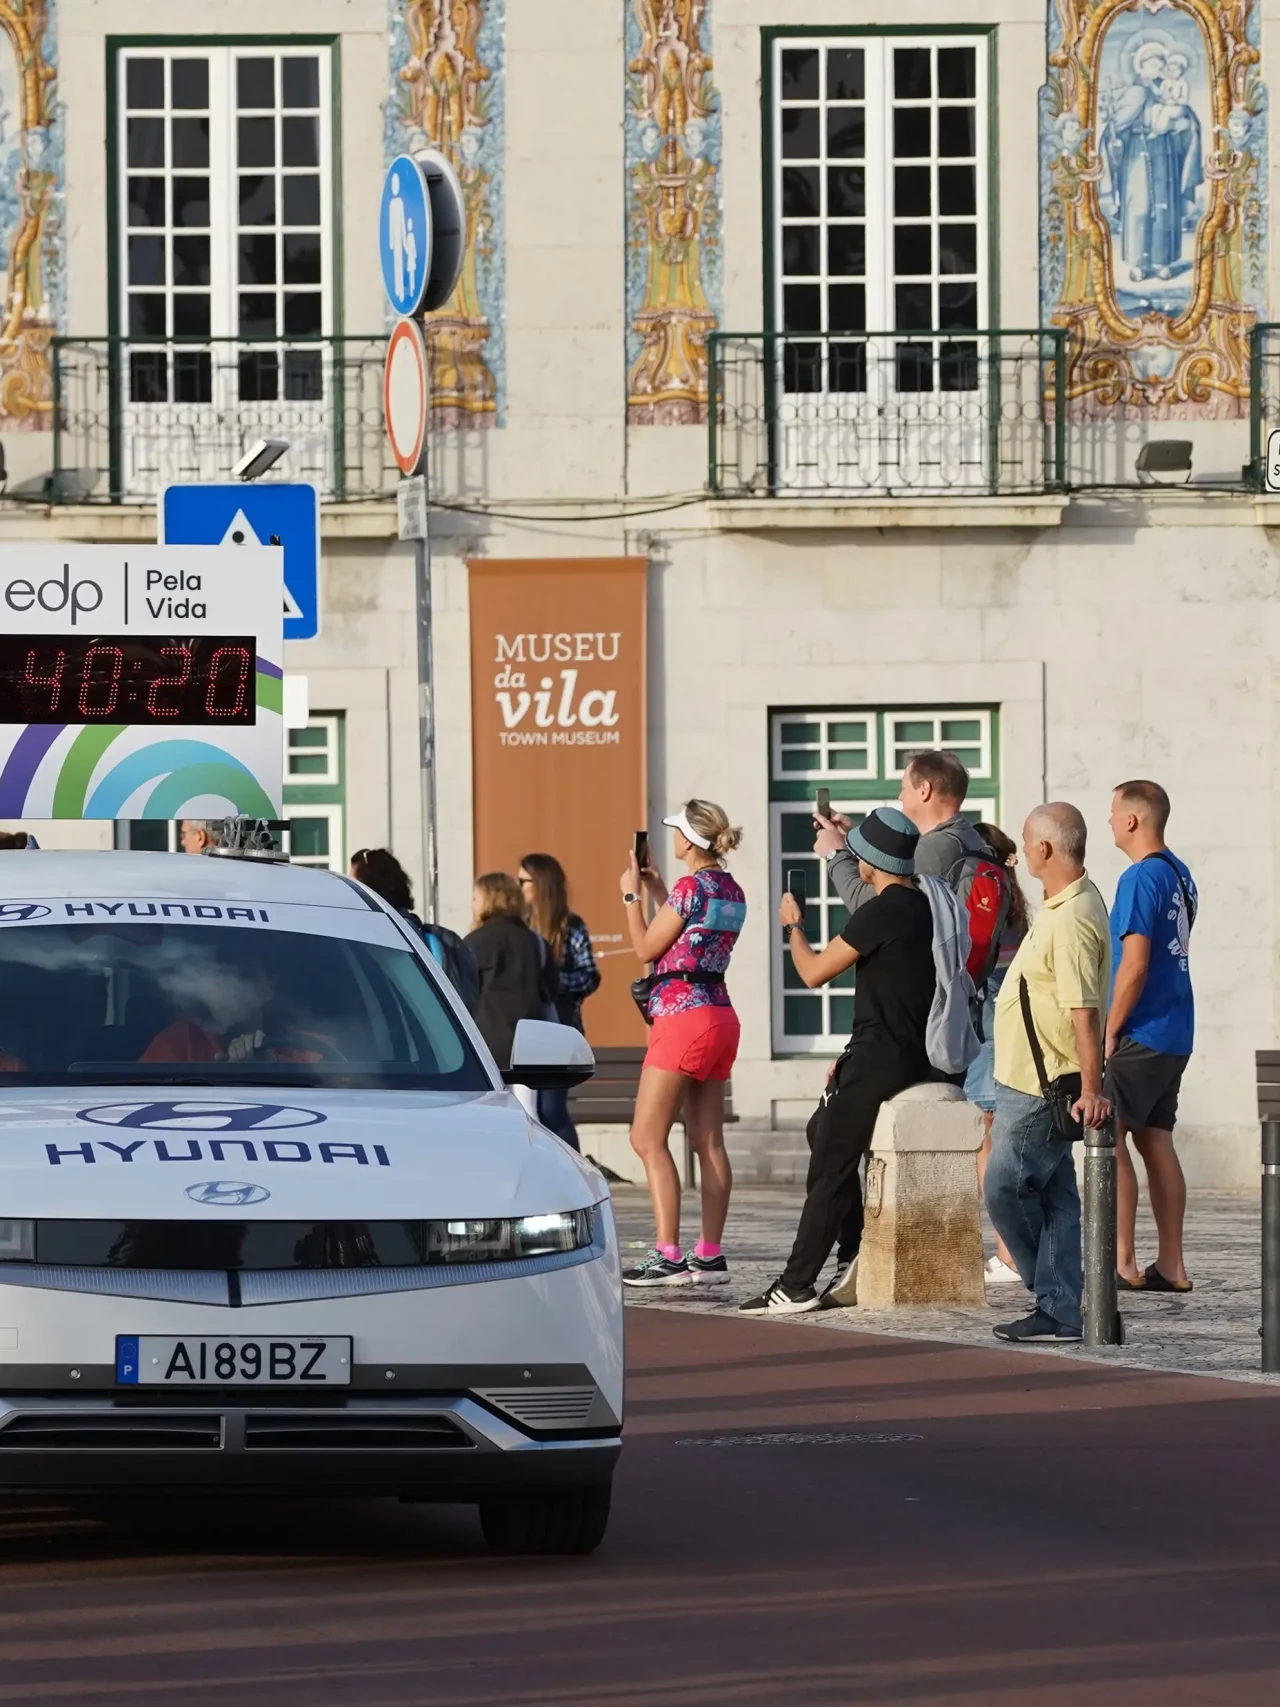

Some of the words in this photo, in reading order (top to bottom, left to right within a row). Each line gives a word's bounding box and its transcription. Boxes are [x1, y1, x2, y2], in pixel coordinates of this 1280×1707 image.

[146, 569, 202, 591] Pela
[5, 563, 103, 625] edp
[146, 597, 207, 619] Vida
[494, 632, 622, 662] MUSEU
[24, 646, 250, 716] 40:20
[493, 663, 527, 688] da
[494, 668, 620, 728] vila
[498, 732, 548, 746] TOWN
[551, 731, 620, 745] MUSEUM
[64, 903, 270, 923] HYUNDAI
[44, 1140, 391, 1166] HYUNDAI
[123, 1365, 133, 1376] P
